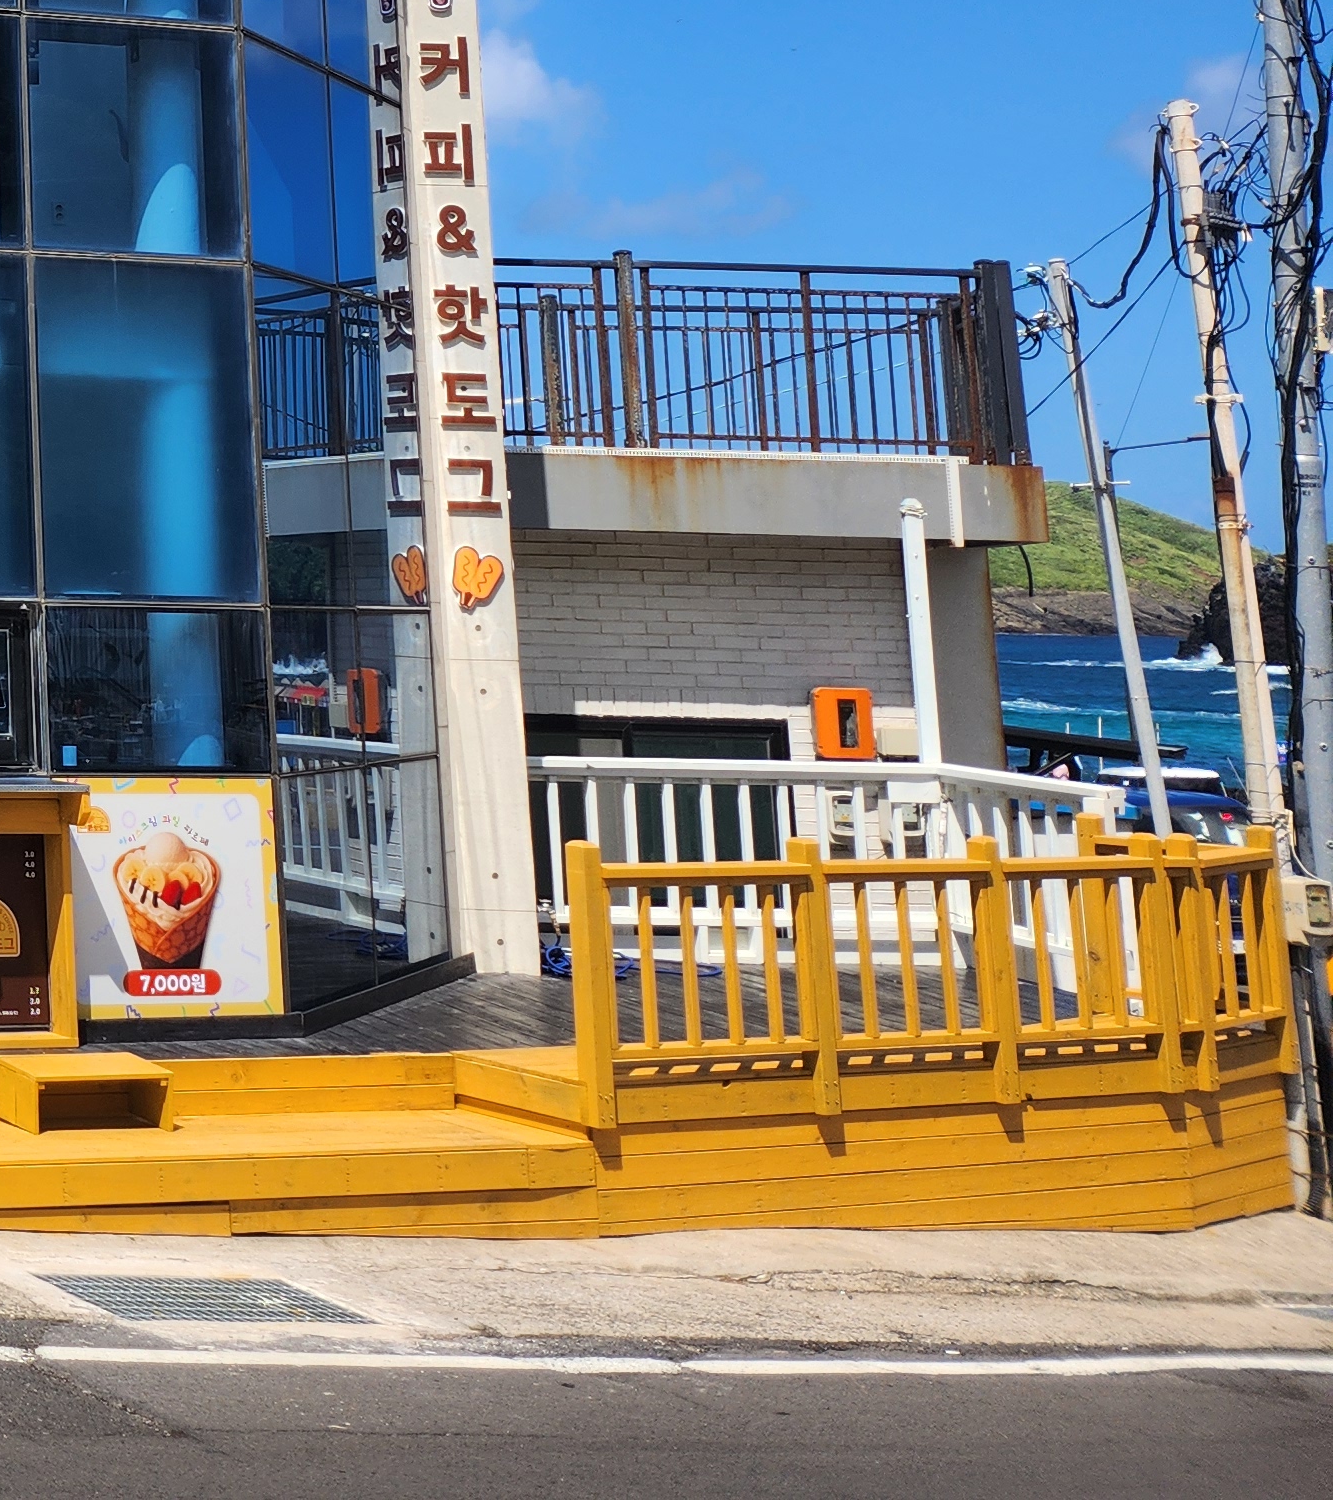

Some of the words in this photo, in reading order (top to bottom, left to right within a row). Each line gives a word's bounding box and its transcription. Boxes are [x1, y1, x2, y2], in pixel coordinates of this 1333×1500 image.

[419, 36, 475, 184] 커피
[437, 204, 478, 253] &
[433, 284, 502, 512] 핫도그
[119, 815, 158, 845] 아이스크림
[139, 973, 206, 994] 7,000원
